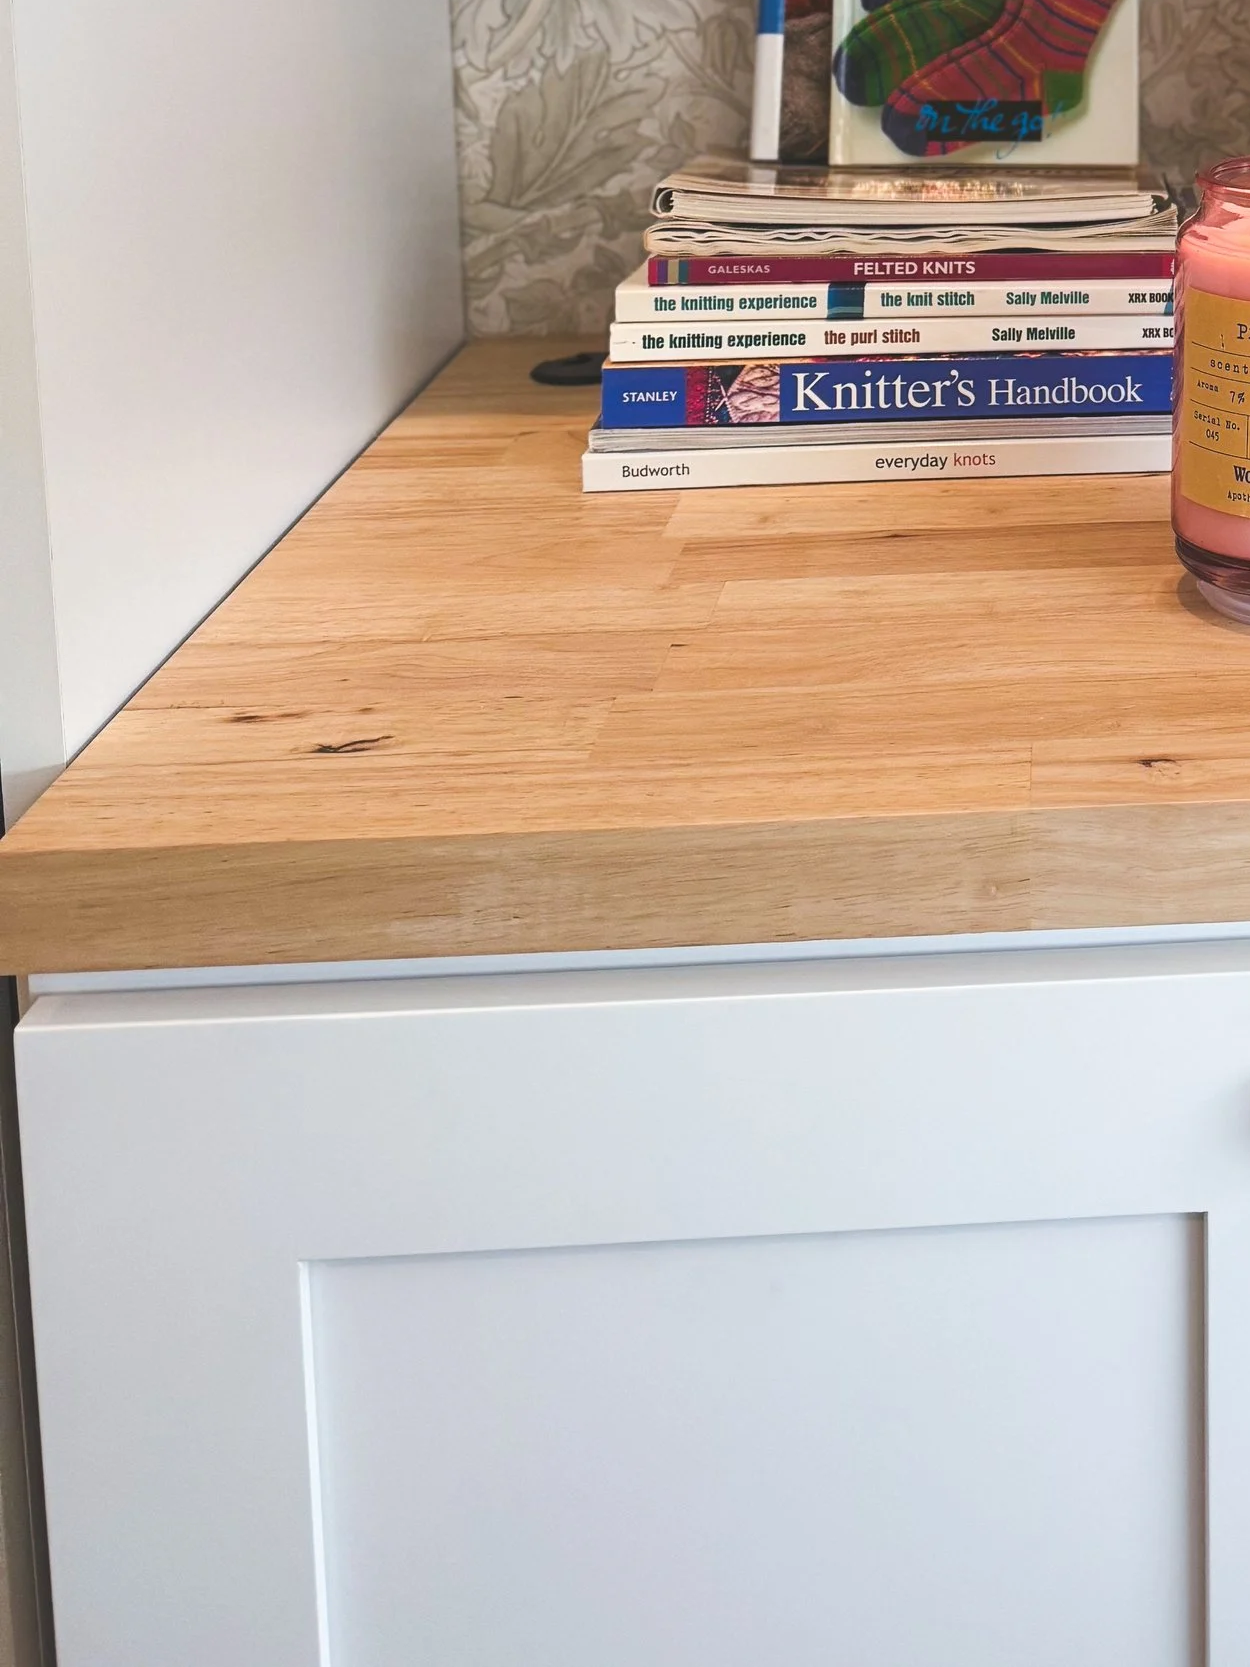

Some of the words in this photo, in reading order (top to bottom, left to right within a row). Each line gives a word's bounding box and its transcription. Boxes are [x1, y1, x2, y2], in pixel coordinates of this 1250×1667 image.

[914, 103, 956, 135] on
[955, 98, 1005, 135] the
[707, 264, 771, 276] GALESKAS
[853, 261, 918, 276] FELTED
[922, 260, 976, 276] KNITS
[654, 296, 677, 312] the
[681, 295, 734, 312] knitting
[738, 294, 817, 311] experience
[880, 292, 902, 308] the
[907, 291, 933, 307] knit
[937, 290, 975, 306] stitch
[1005, 291, 1038, 308] Sally
[1040, 290, 1090, 305] Melville
[1128, 292, 1147, 304] XRX
[641, 334, 664, 350] the
[669, 333, 723, 350] knitting
[727, 332, 806, 348] experience
[824, 330, 847, 345] the
[850, 328, 877, 346] purl
[881, 327, 920, 344] stitch
[991, 327, 1023, 344] Sally
[1025, 327, 1076, 342] Melville
[1142, 328, 1161, 339] XRX
[791, 369, 976, 412] Knitter's
[988, 375, 1143, 406] Handbook
[1197, 379, 1219, 393] Aroma
[622, 391, 678, 403] STANLEY
[1229, 390, 1245, 404] 7%
[1193, 410, 1221, 427] Serial
[1225, 420, 1241, 431] No.
[1205, 429, 1220, 442] 045
[875, 453, 948, 472] everyday
[953, 451, 996, 467] knots
[621, 463, 691, 478] Budworth
